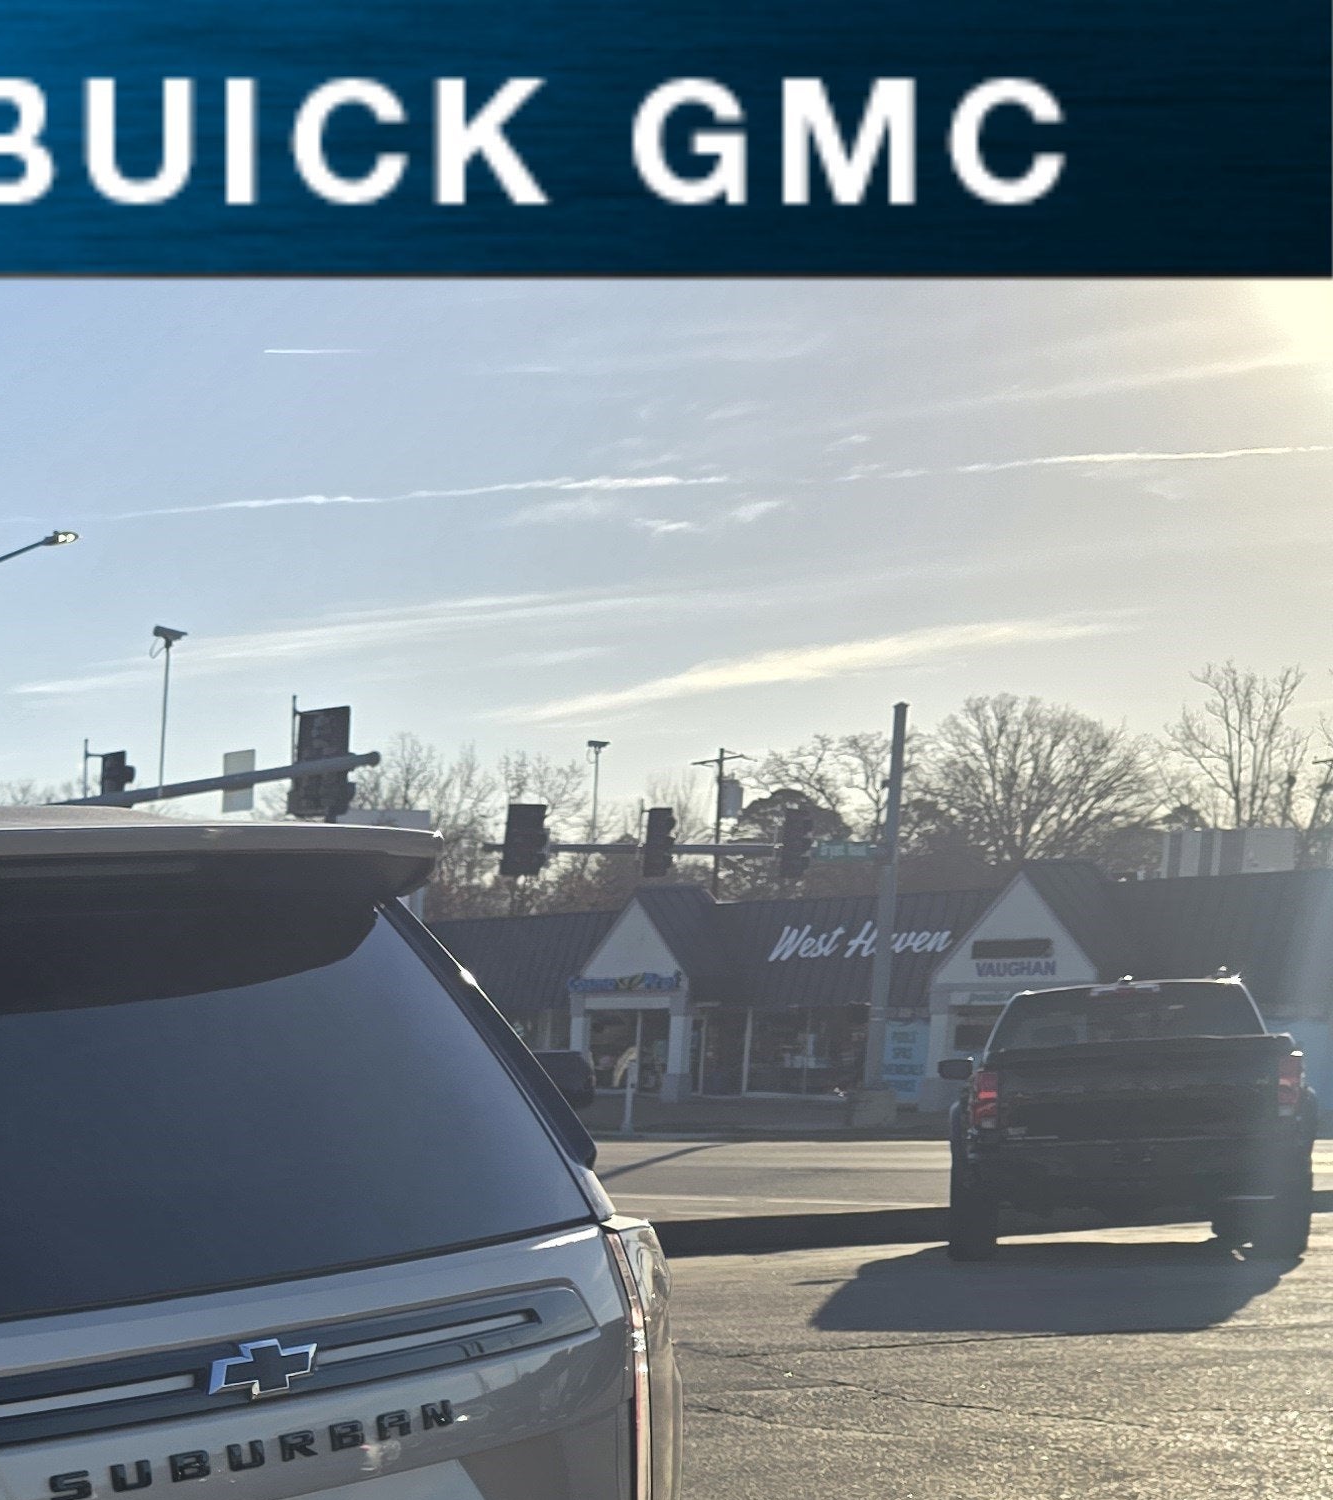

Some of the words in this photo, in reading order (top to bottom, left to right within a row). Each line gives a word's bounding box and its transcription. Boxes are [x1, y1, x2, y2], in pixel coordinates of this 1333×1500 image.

[767, 923, 845, 962] West
[843, 920, 952, 958] Hven
[974, 960, 1057, 978] VAUGHAN
